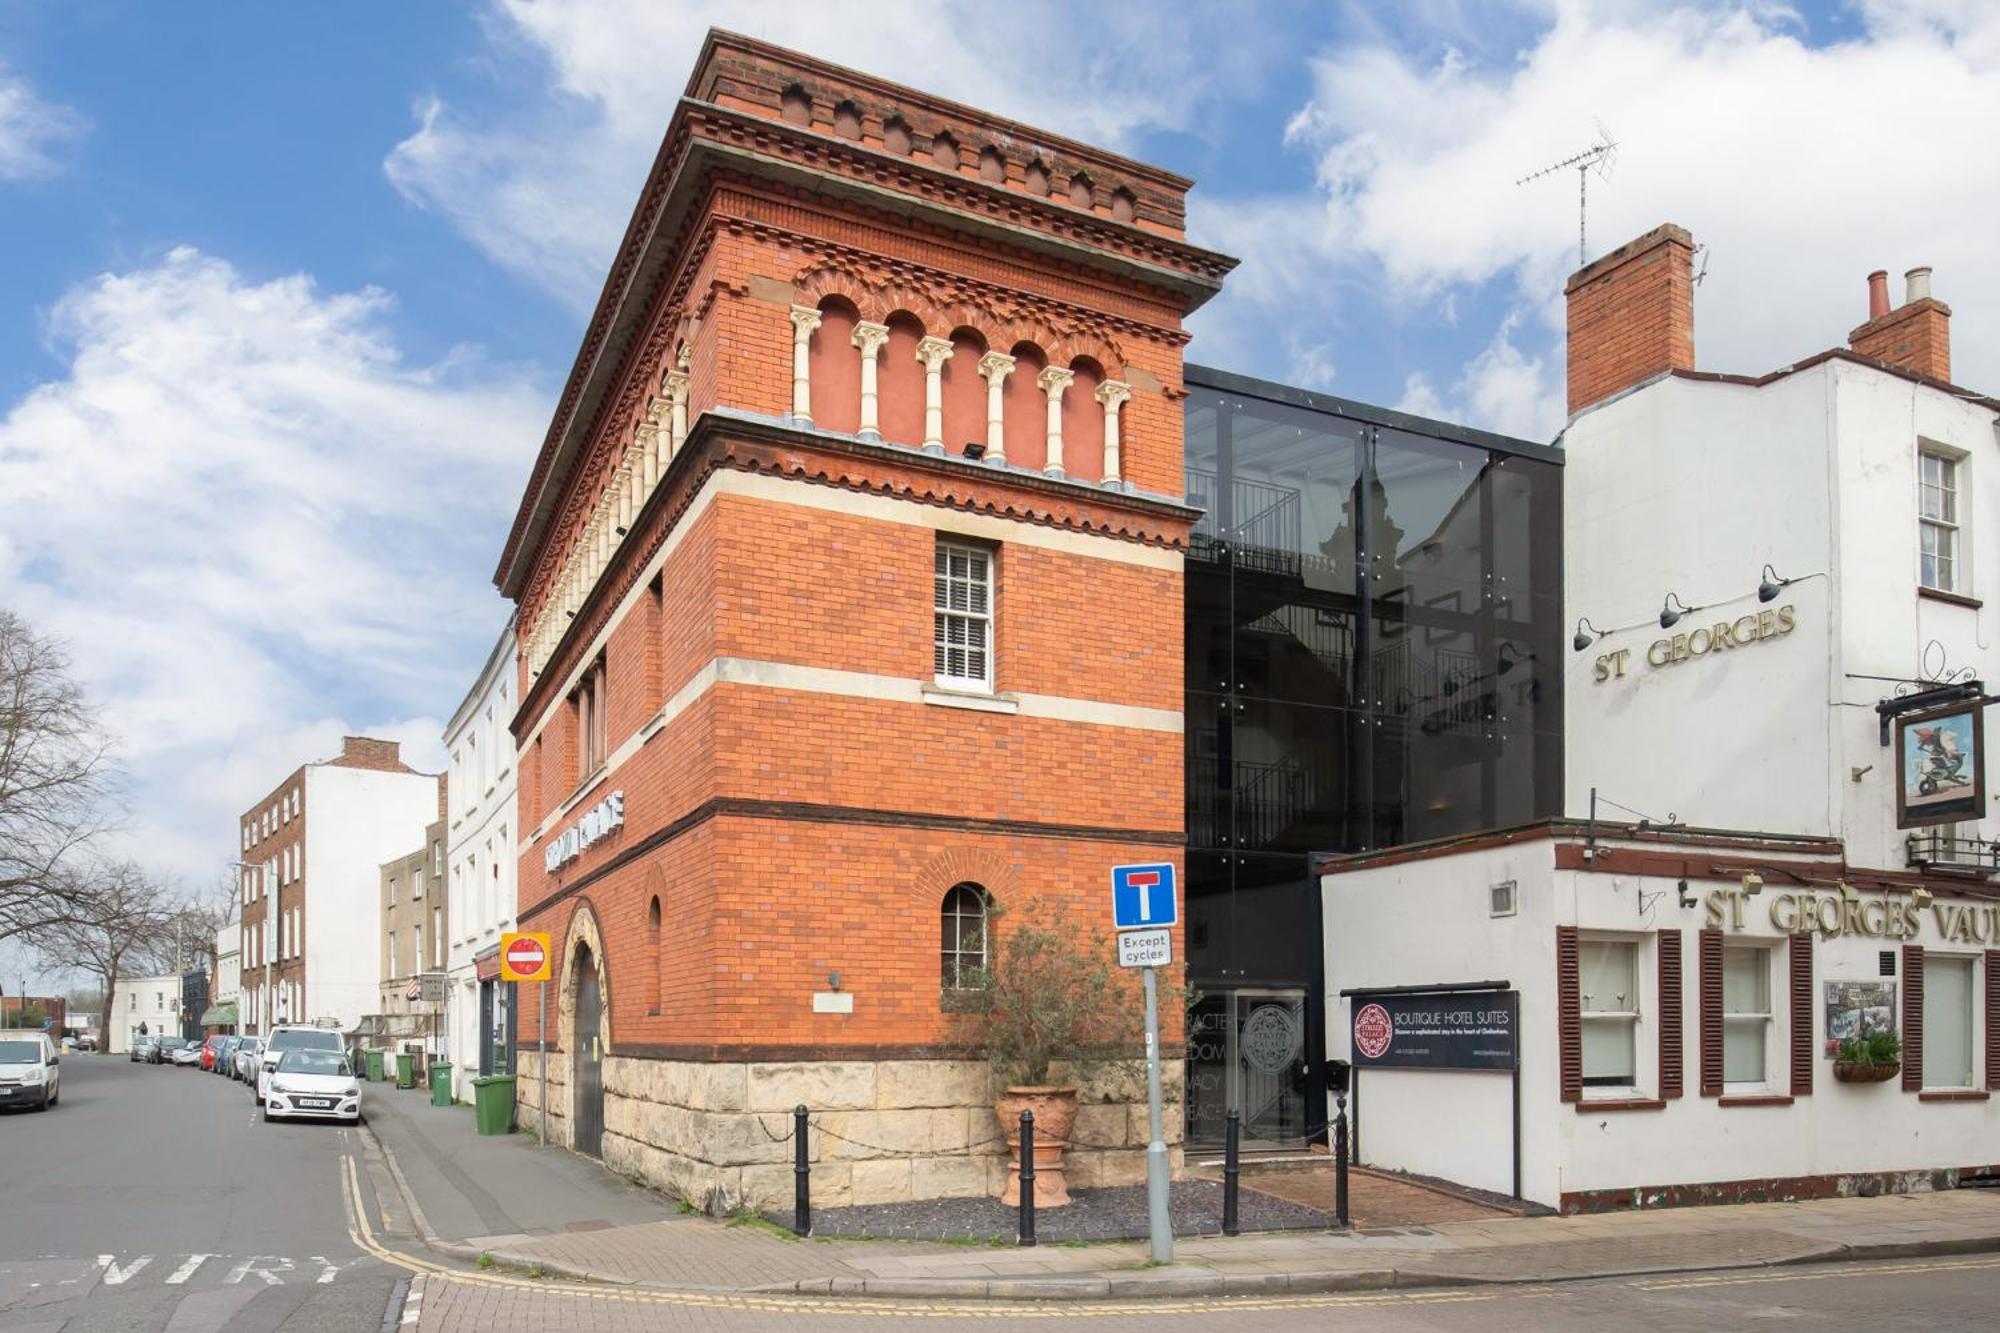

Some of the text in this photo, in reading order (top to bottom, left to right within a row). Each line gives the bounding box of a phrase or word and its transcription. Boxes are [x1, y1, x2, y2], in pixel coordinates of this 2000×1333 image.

[1593, 604, 1797, 683] ST GEORGES
[1705, 889, 1748, 930] ST
[1770, 893, 1922, 939] GEORGES
[1123, 936, 1166, 948] Except
[1126, 949, 1164, 962] cycles
[1394, 1010, 1509, 1026] BOUTIQUE HOTEL SUITES
